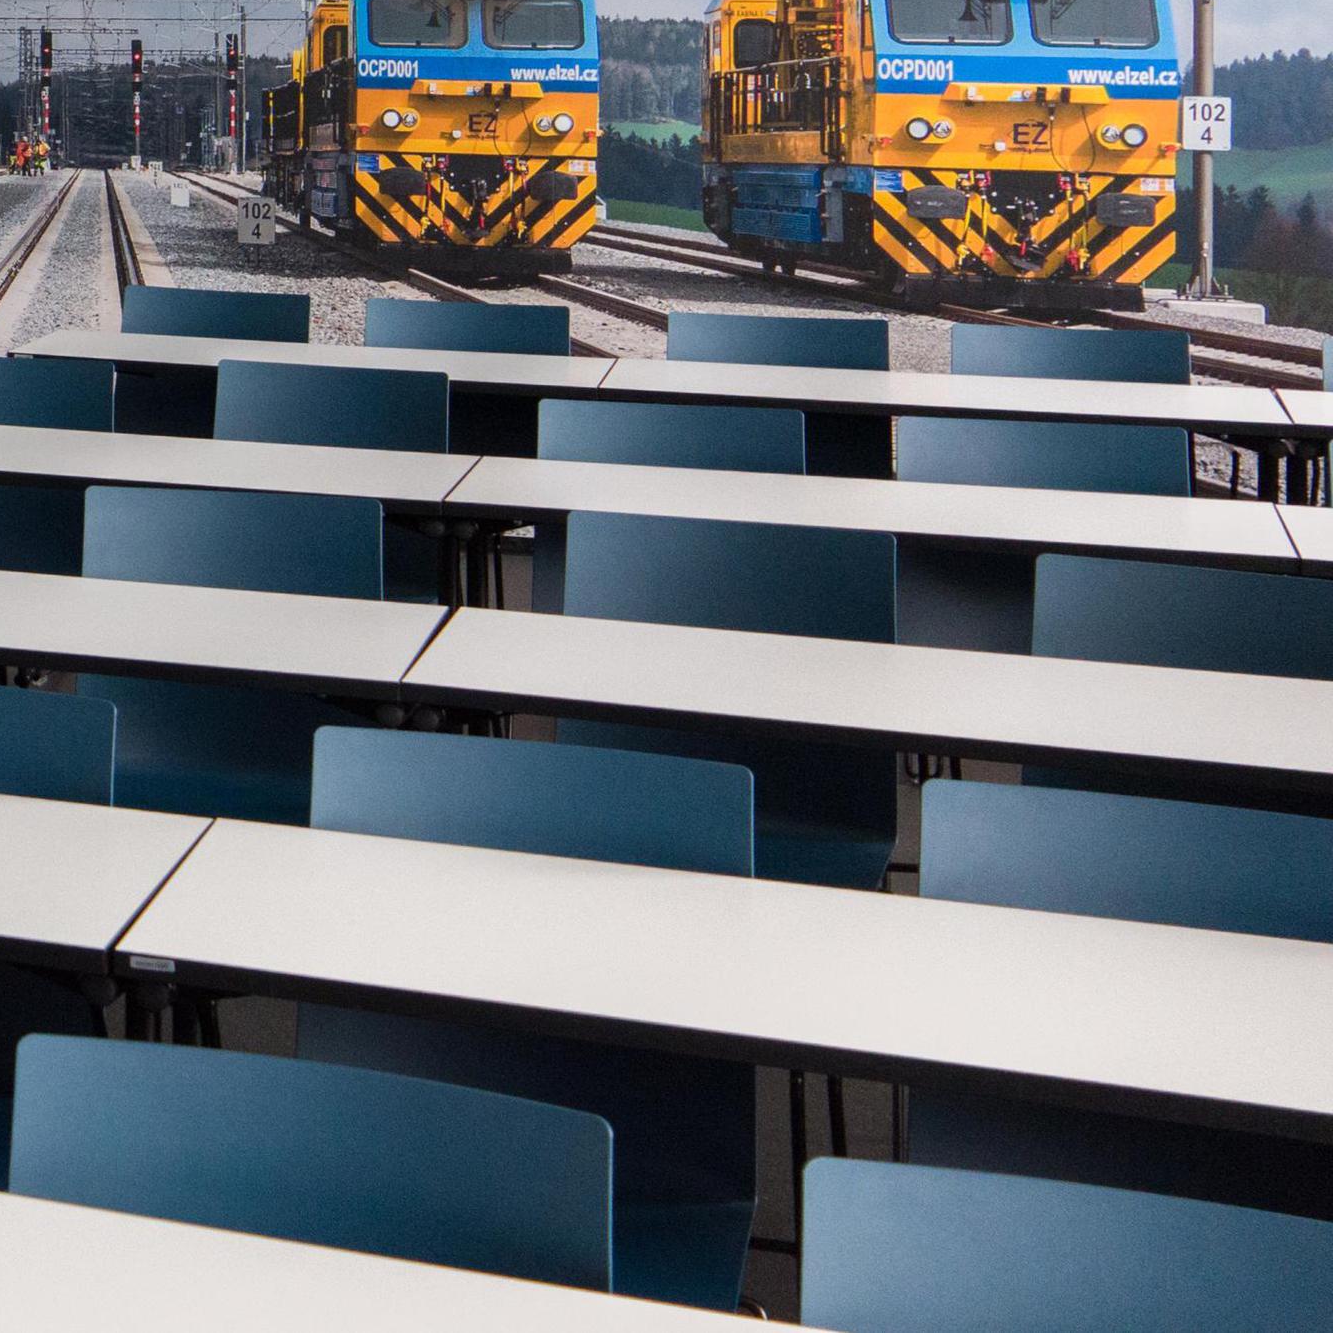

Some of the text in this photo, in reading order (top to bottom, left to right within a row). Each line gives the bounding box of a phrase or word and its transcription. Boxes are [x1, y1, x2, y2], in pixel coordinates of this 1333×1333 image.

[358, 58, 598, 82] OCPD001 www.elzel.cz
[877, 58, 1179, 86] OCPD001 www.elzel.cz
[1189, 103, 1226, 122] 102
[1200, 126, 1213, 145] 4
[241, 201, 271, 220] 102
[251, 222, 262, 239] 4
